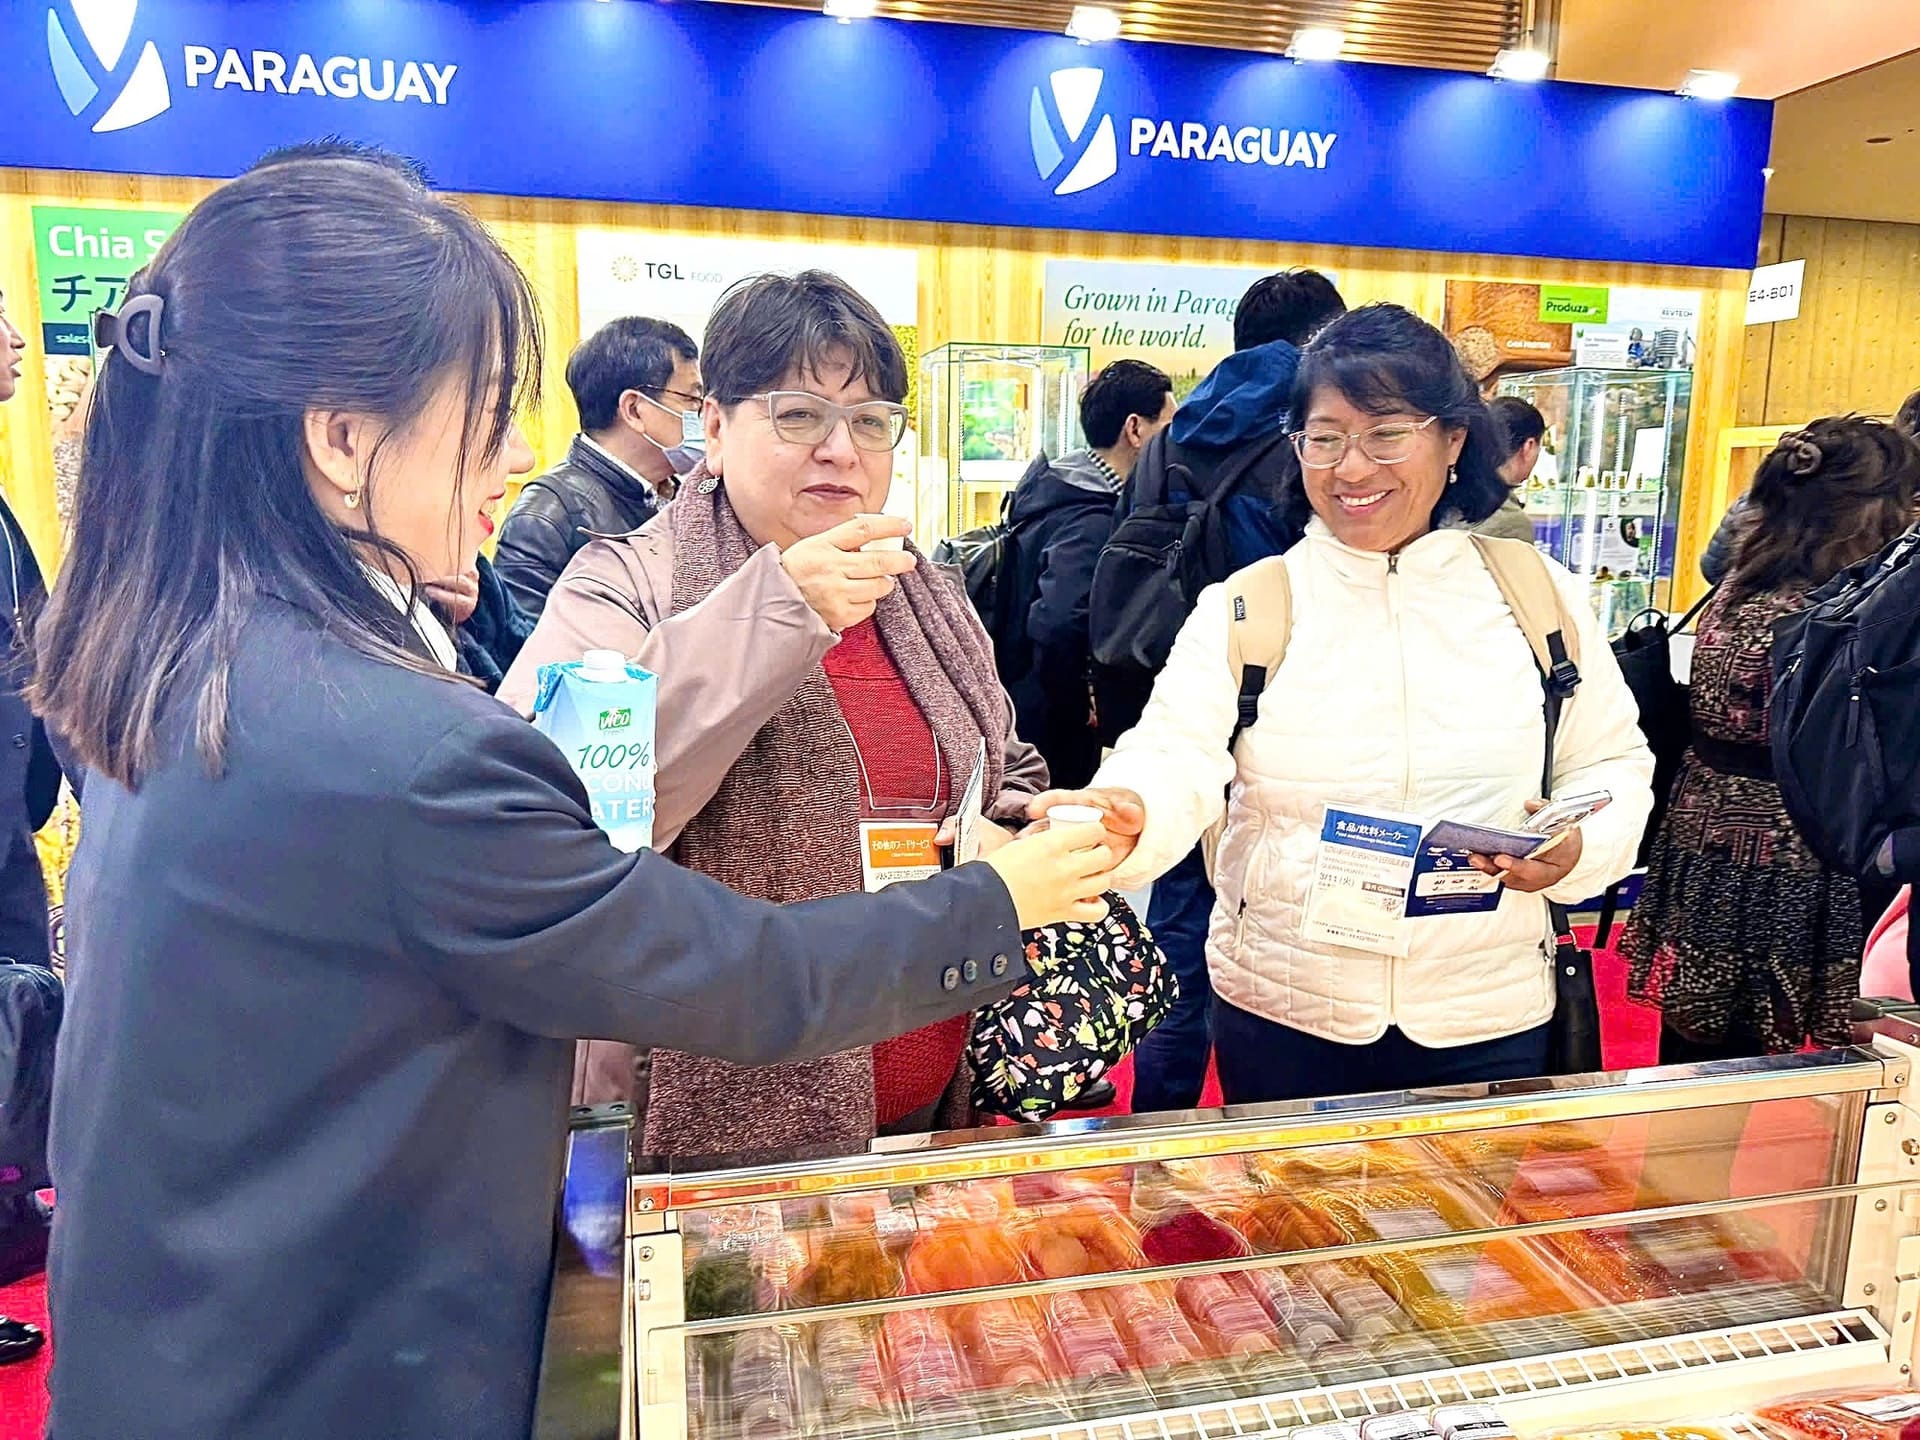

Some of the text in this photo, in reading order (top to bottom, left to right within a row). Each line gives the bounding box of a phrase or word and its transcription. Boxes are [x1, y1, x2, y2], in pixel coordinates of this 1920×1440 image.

[184, 45, 457, 104] PARAGUAY
[1130, 118, 1336, 169] PARAGUAY
[49, 225, 134, 258] Chia
[645, 263, 723, 283] TGL FOOD
[52, 275, 128, 312] チア
[1065, 285, 1240, 321] Grown in Parag
[1546, 301, 1589, 313] Produza
[1749, 284, 1793, 302] E4-B01
[1063, 318, 1207, 348] for the world.
[578, 741, 649, 770] 100%
[592, 797, 652, 820] ATER
[1336, 820, 1409, 841] 食品/飲料メーカー
